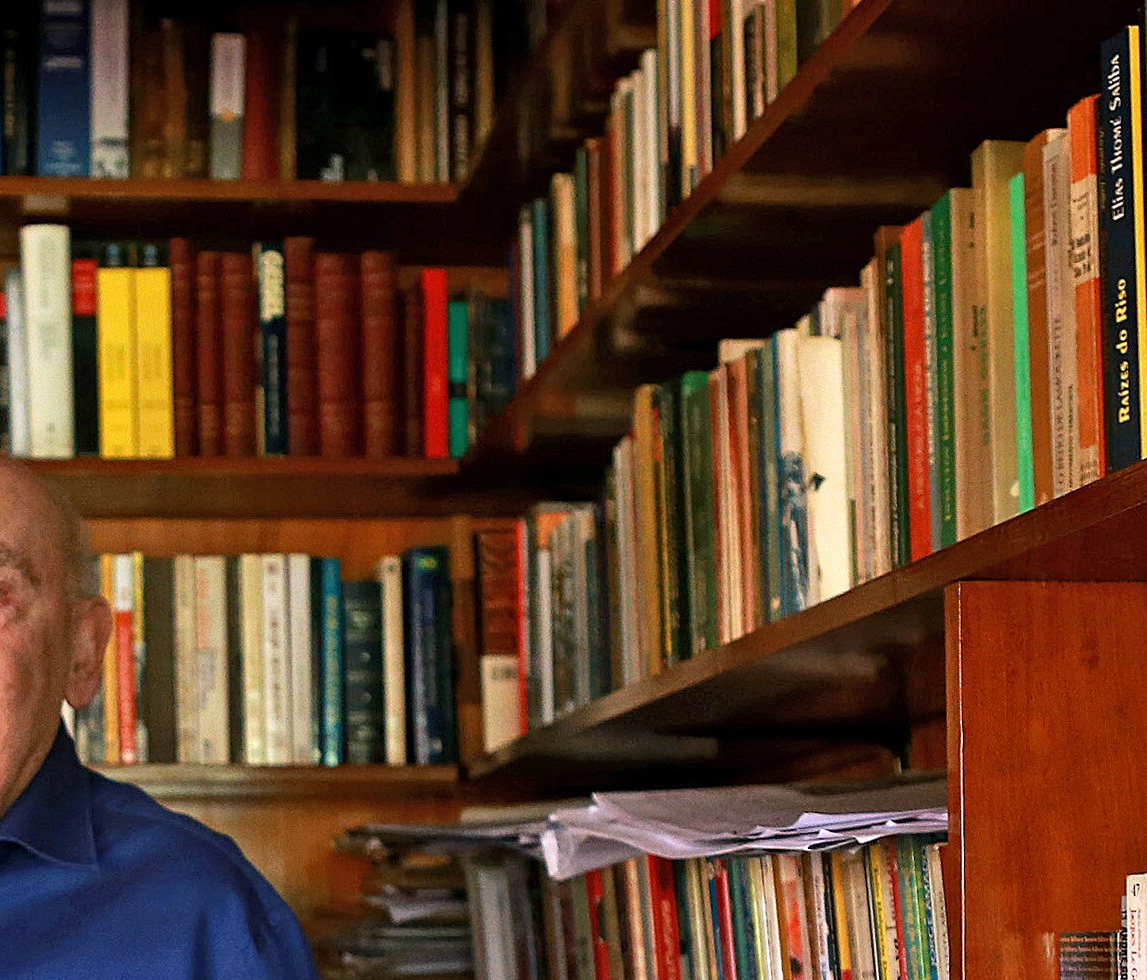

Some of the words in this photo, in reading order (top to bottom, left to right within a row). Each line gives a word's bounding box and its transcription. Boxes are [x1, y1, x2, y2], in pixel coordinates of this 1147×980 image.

[1107, 53, 1121, 112] Saliba
[1111, 178, 1125, 222] Elias
[1114, 278, 1127, 323] Riso
[1115, 330, 1128, 354] do
[1117, 363, 1130, 424] Raízes
[1130, 951, 1138, 964] Le
